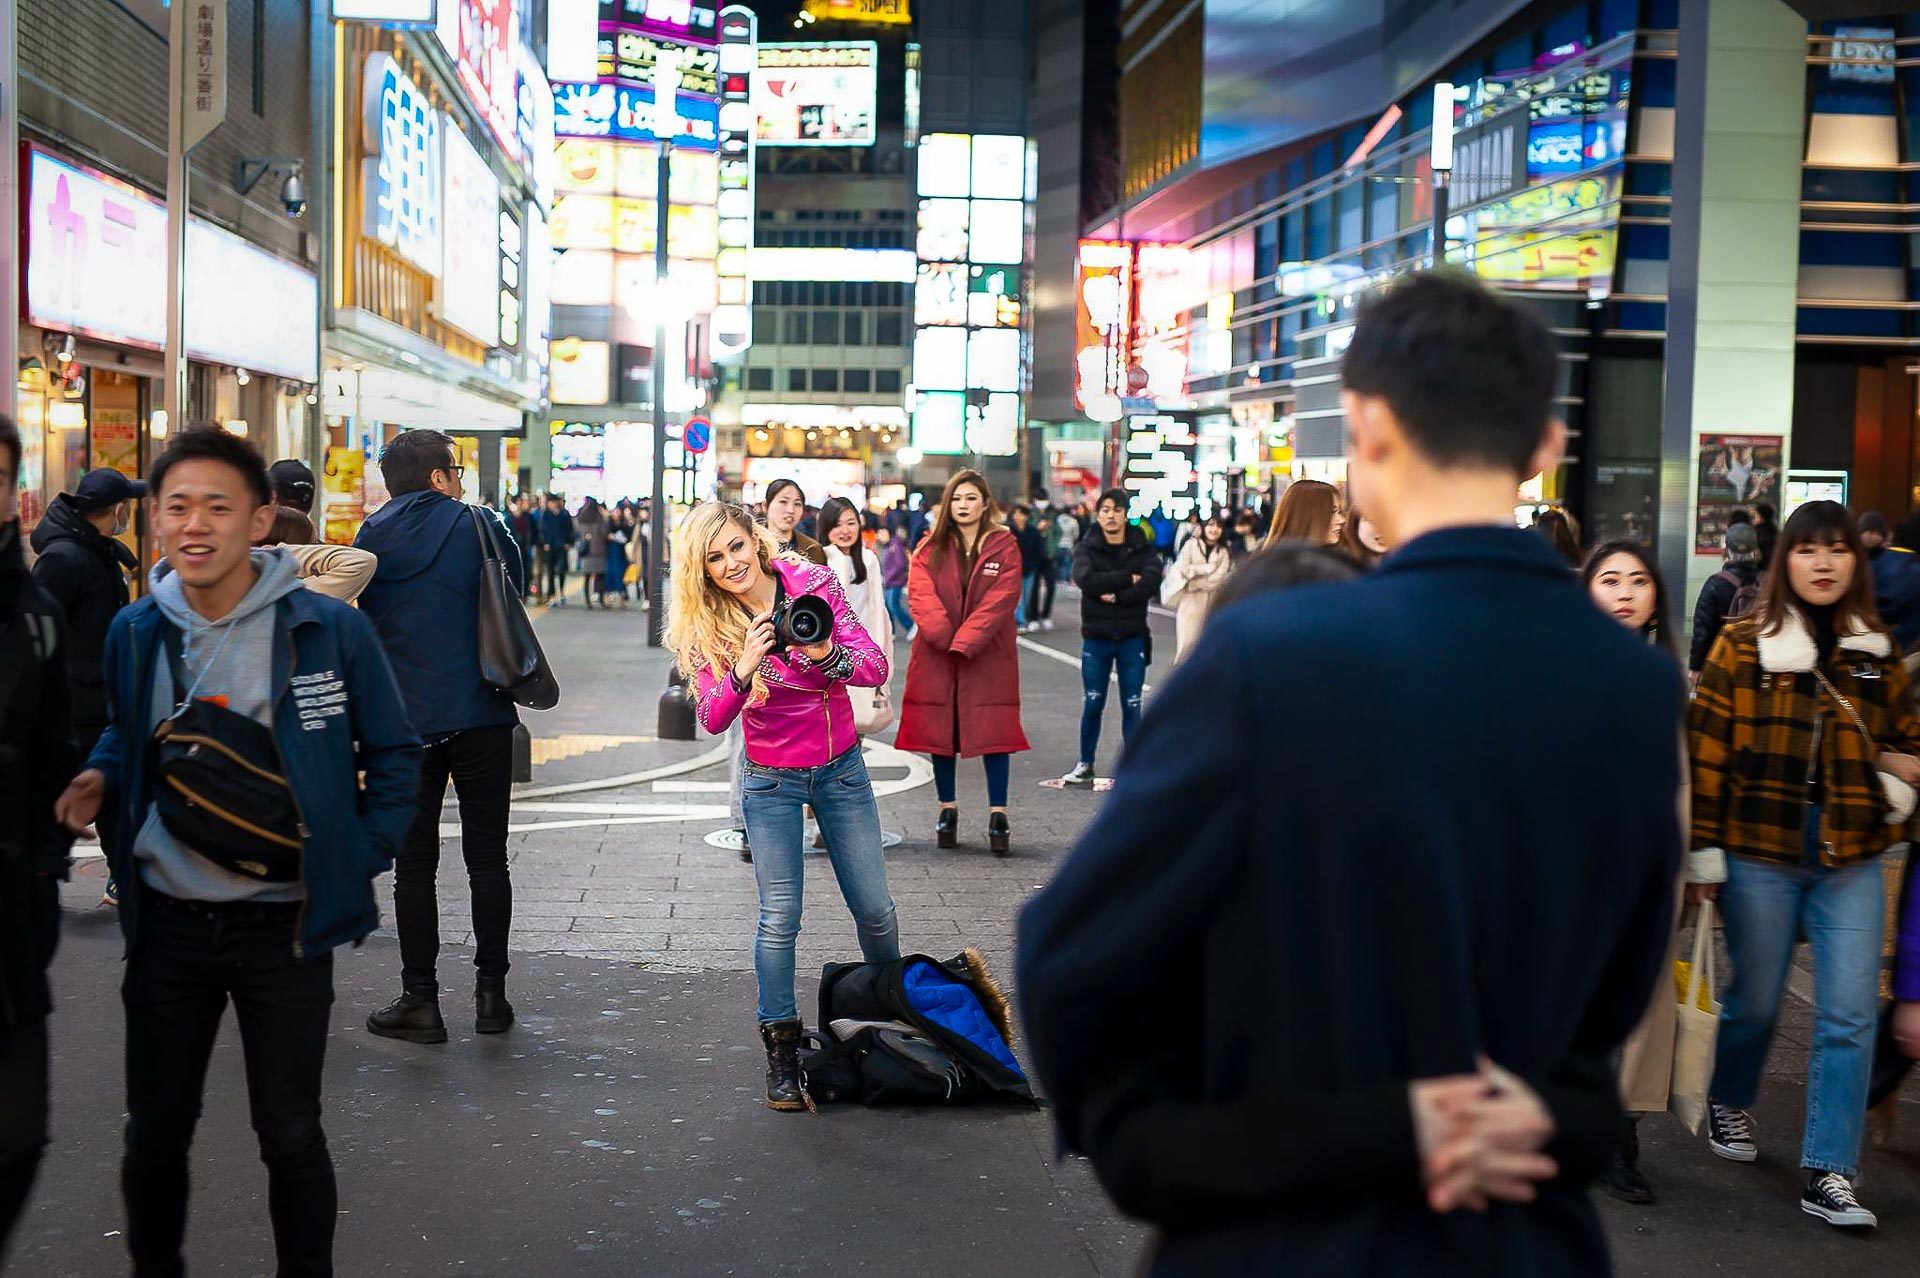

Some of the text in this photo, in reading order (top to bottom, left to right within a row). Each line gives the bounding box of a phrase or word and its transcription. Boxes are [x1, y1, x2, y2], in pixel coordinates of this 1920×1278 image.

[196, 4, 214, 112] 劇場通り一番街
